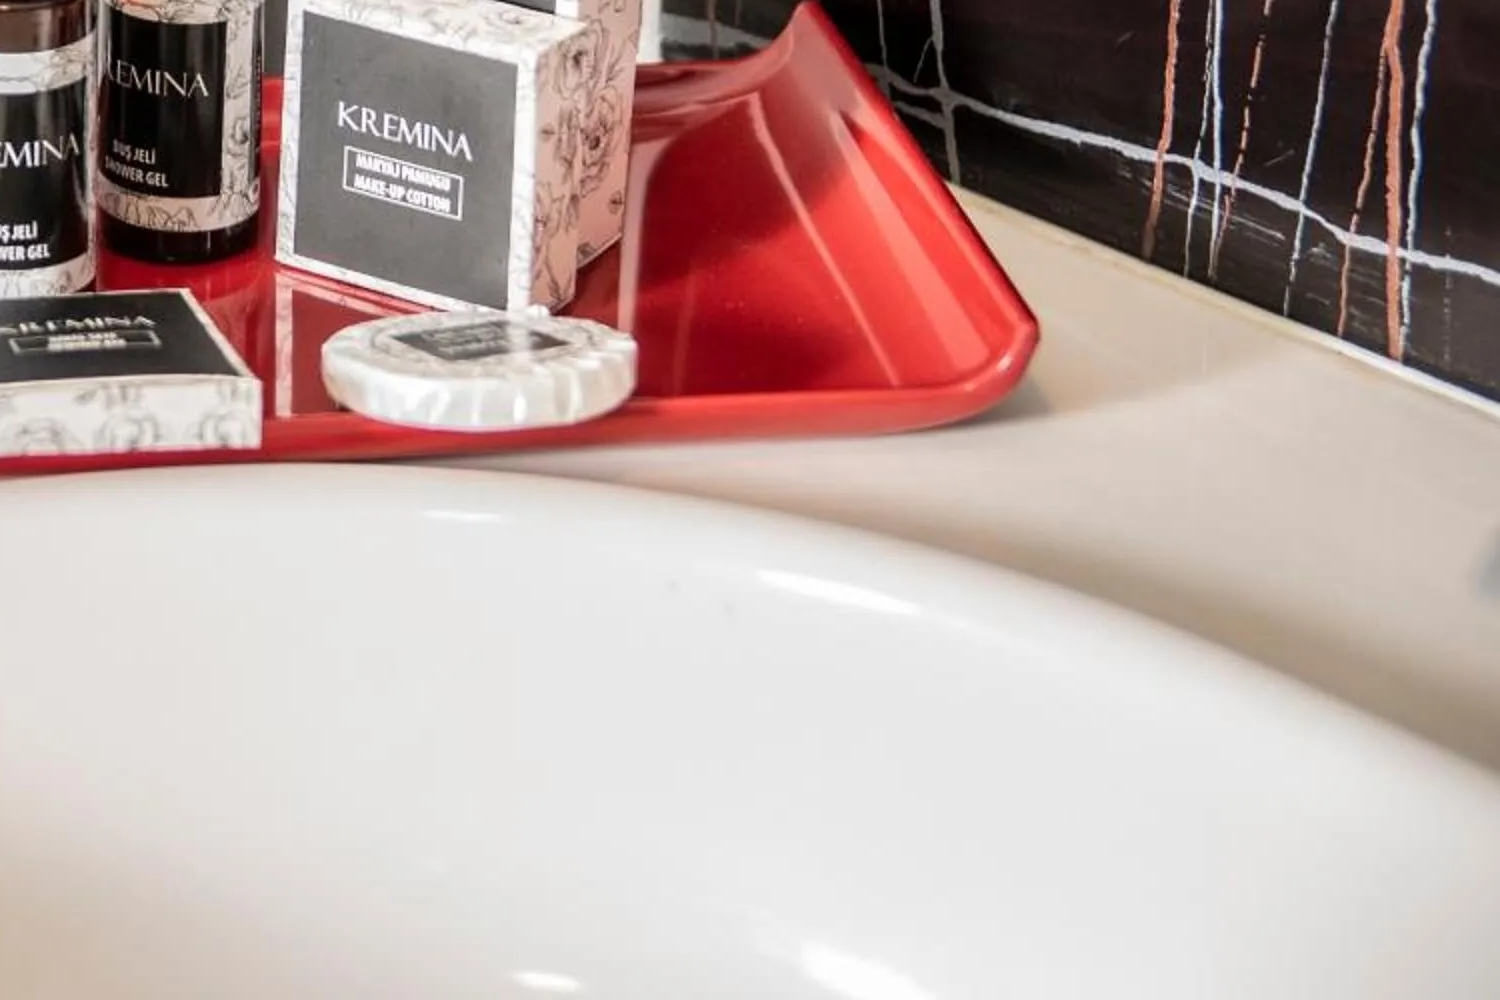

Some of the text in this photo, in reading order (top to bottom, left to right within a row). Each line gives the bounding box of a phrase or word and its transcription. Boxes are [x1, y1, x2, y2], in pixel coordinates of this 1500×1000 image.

[337, 101, 474, 162] KREMINA
[145, 171, 169, 188] GEL
[353, 173, 451, 213] MAKE-UP COTTON
[26, 243, 50, 259] GEL
